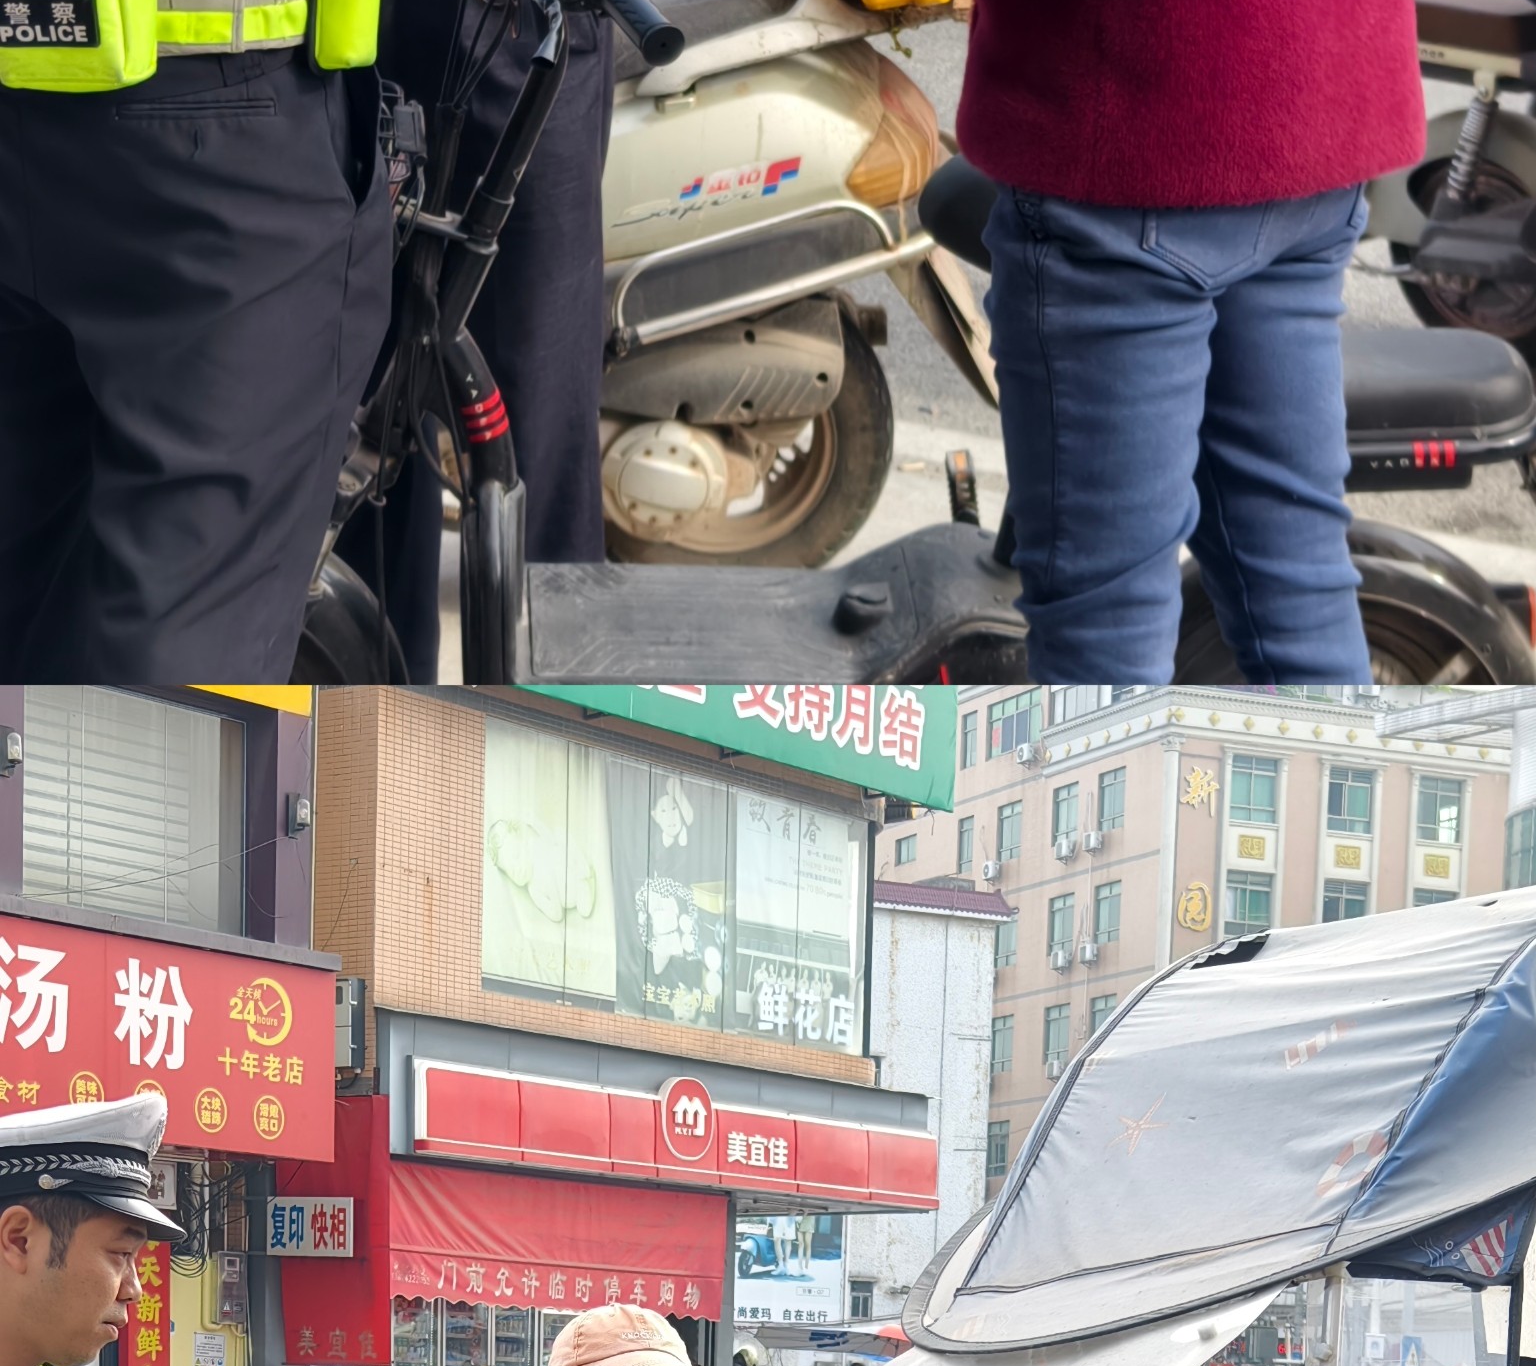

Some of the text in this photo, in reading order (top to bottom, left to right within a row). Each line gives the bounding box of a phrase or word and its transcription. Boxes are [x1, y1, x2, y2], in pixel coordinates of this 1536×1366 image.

[3, 2, 76, 24] 警察
[0, 25, 88, 42] POLICE
[0, 937, 194, 1070] 汤粉
[229, 998, 256, 1025] 24
[757, 982, 854, 1047] 鲜花店
[217, 1047, 304, 1085] 十年老店
[726, 1130, 789, 1170] 美宜佳
[270, 1202, 348, 1251] 复印 快相
[437, 1258, 702, 1311] 门前允许临时停车购物
[735, 1306, 828, 1323] 尚爱玛 自在出行
[296, 1325, 378, 1360] 美宜佳
